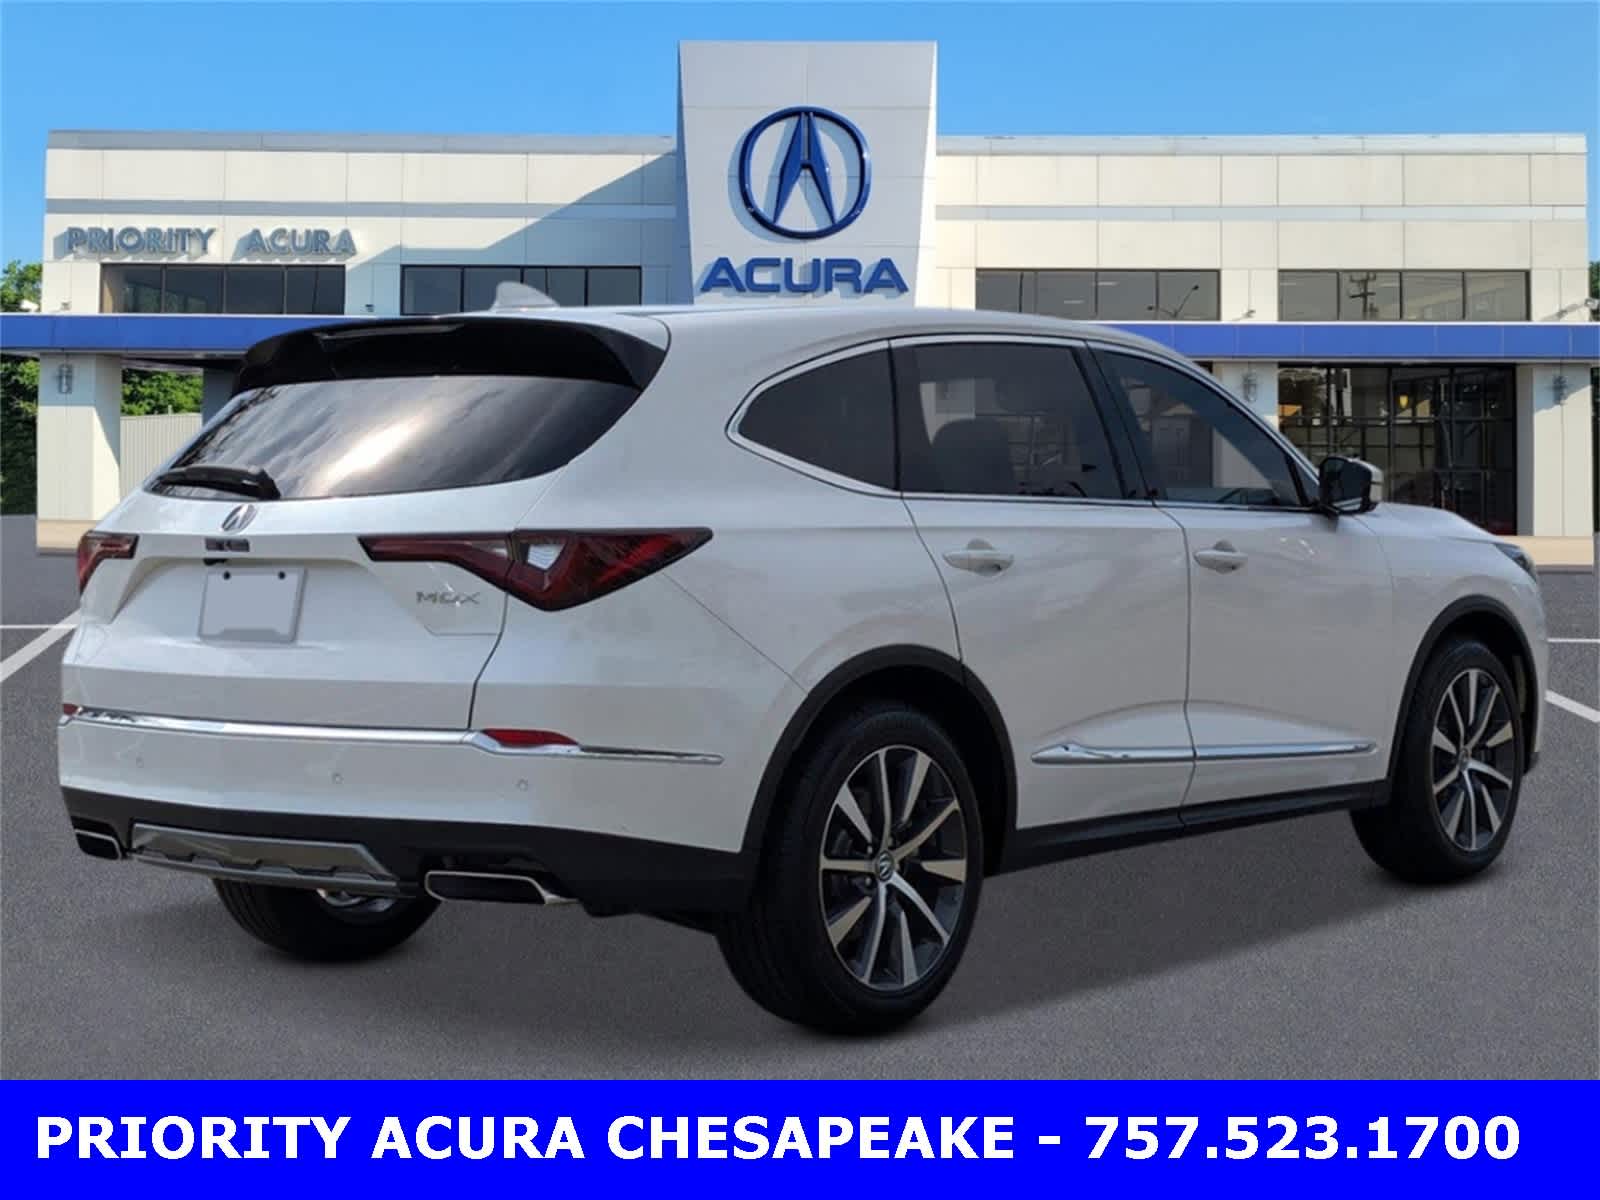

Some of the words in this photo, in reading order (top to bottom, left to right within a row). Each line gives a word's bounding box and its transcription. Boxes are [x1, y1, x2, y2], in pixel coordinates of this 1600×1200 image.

[67, 227, 216, 252] PRIORITY
[247, 228, 356, 253] ACURA
[700, 257, 909, 294] ACURA
